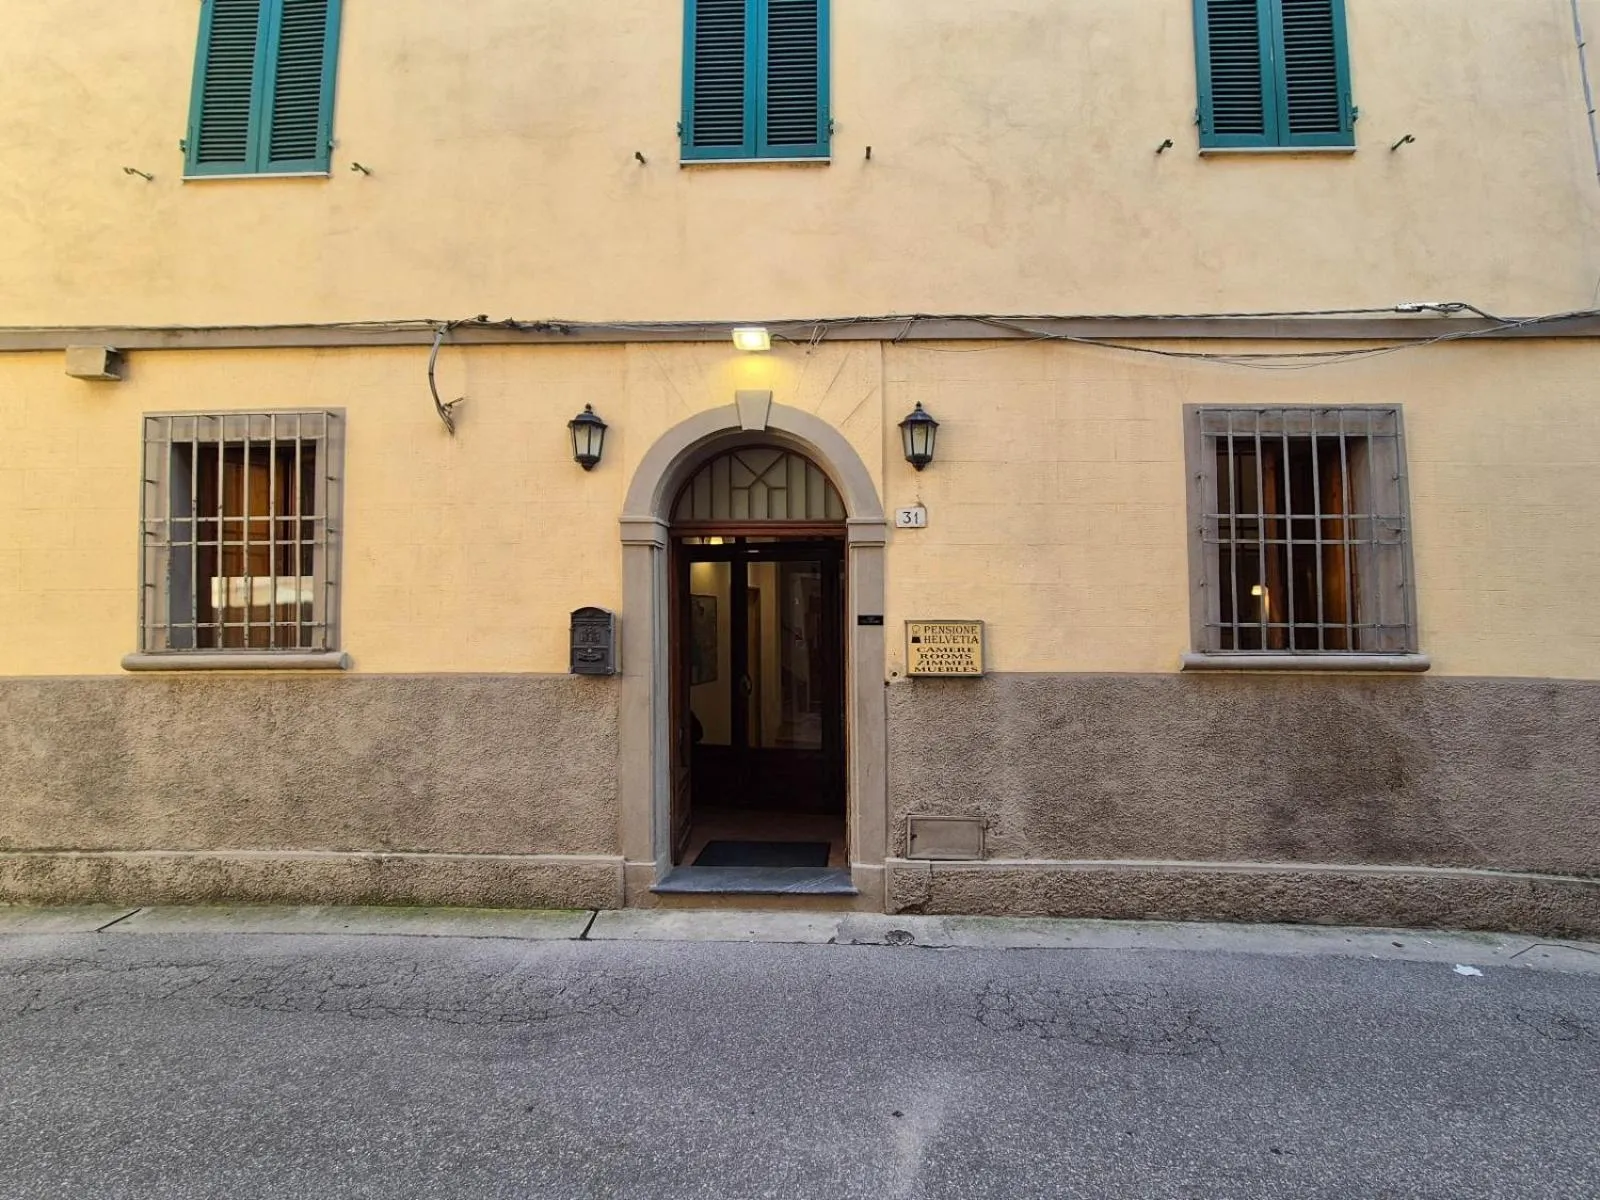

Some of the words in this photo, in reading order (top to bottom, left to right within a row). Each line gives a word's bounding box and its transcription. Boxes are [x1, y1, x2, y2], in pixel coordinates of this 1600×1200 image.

[902, 511, 918, 524] 31
[924, 625, 978, 635] PENSIONE
[924, 635, 979, 644] HELVETIA
